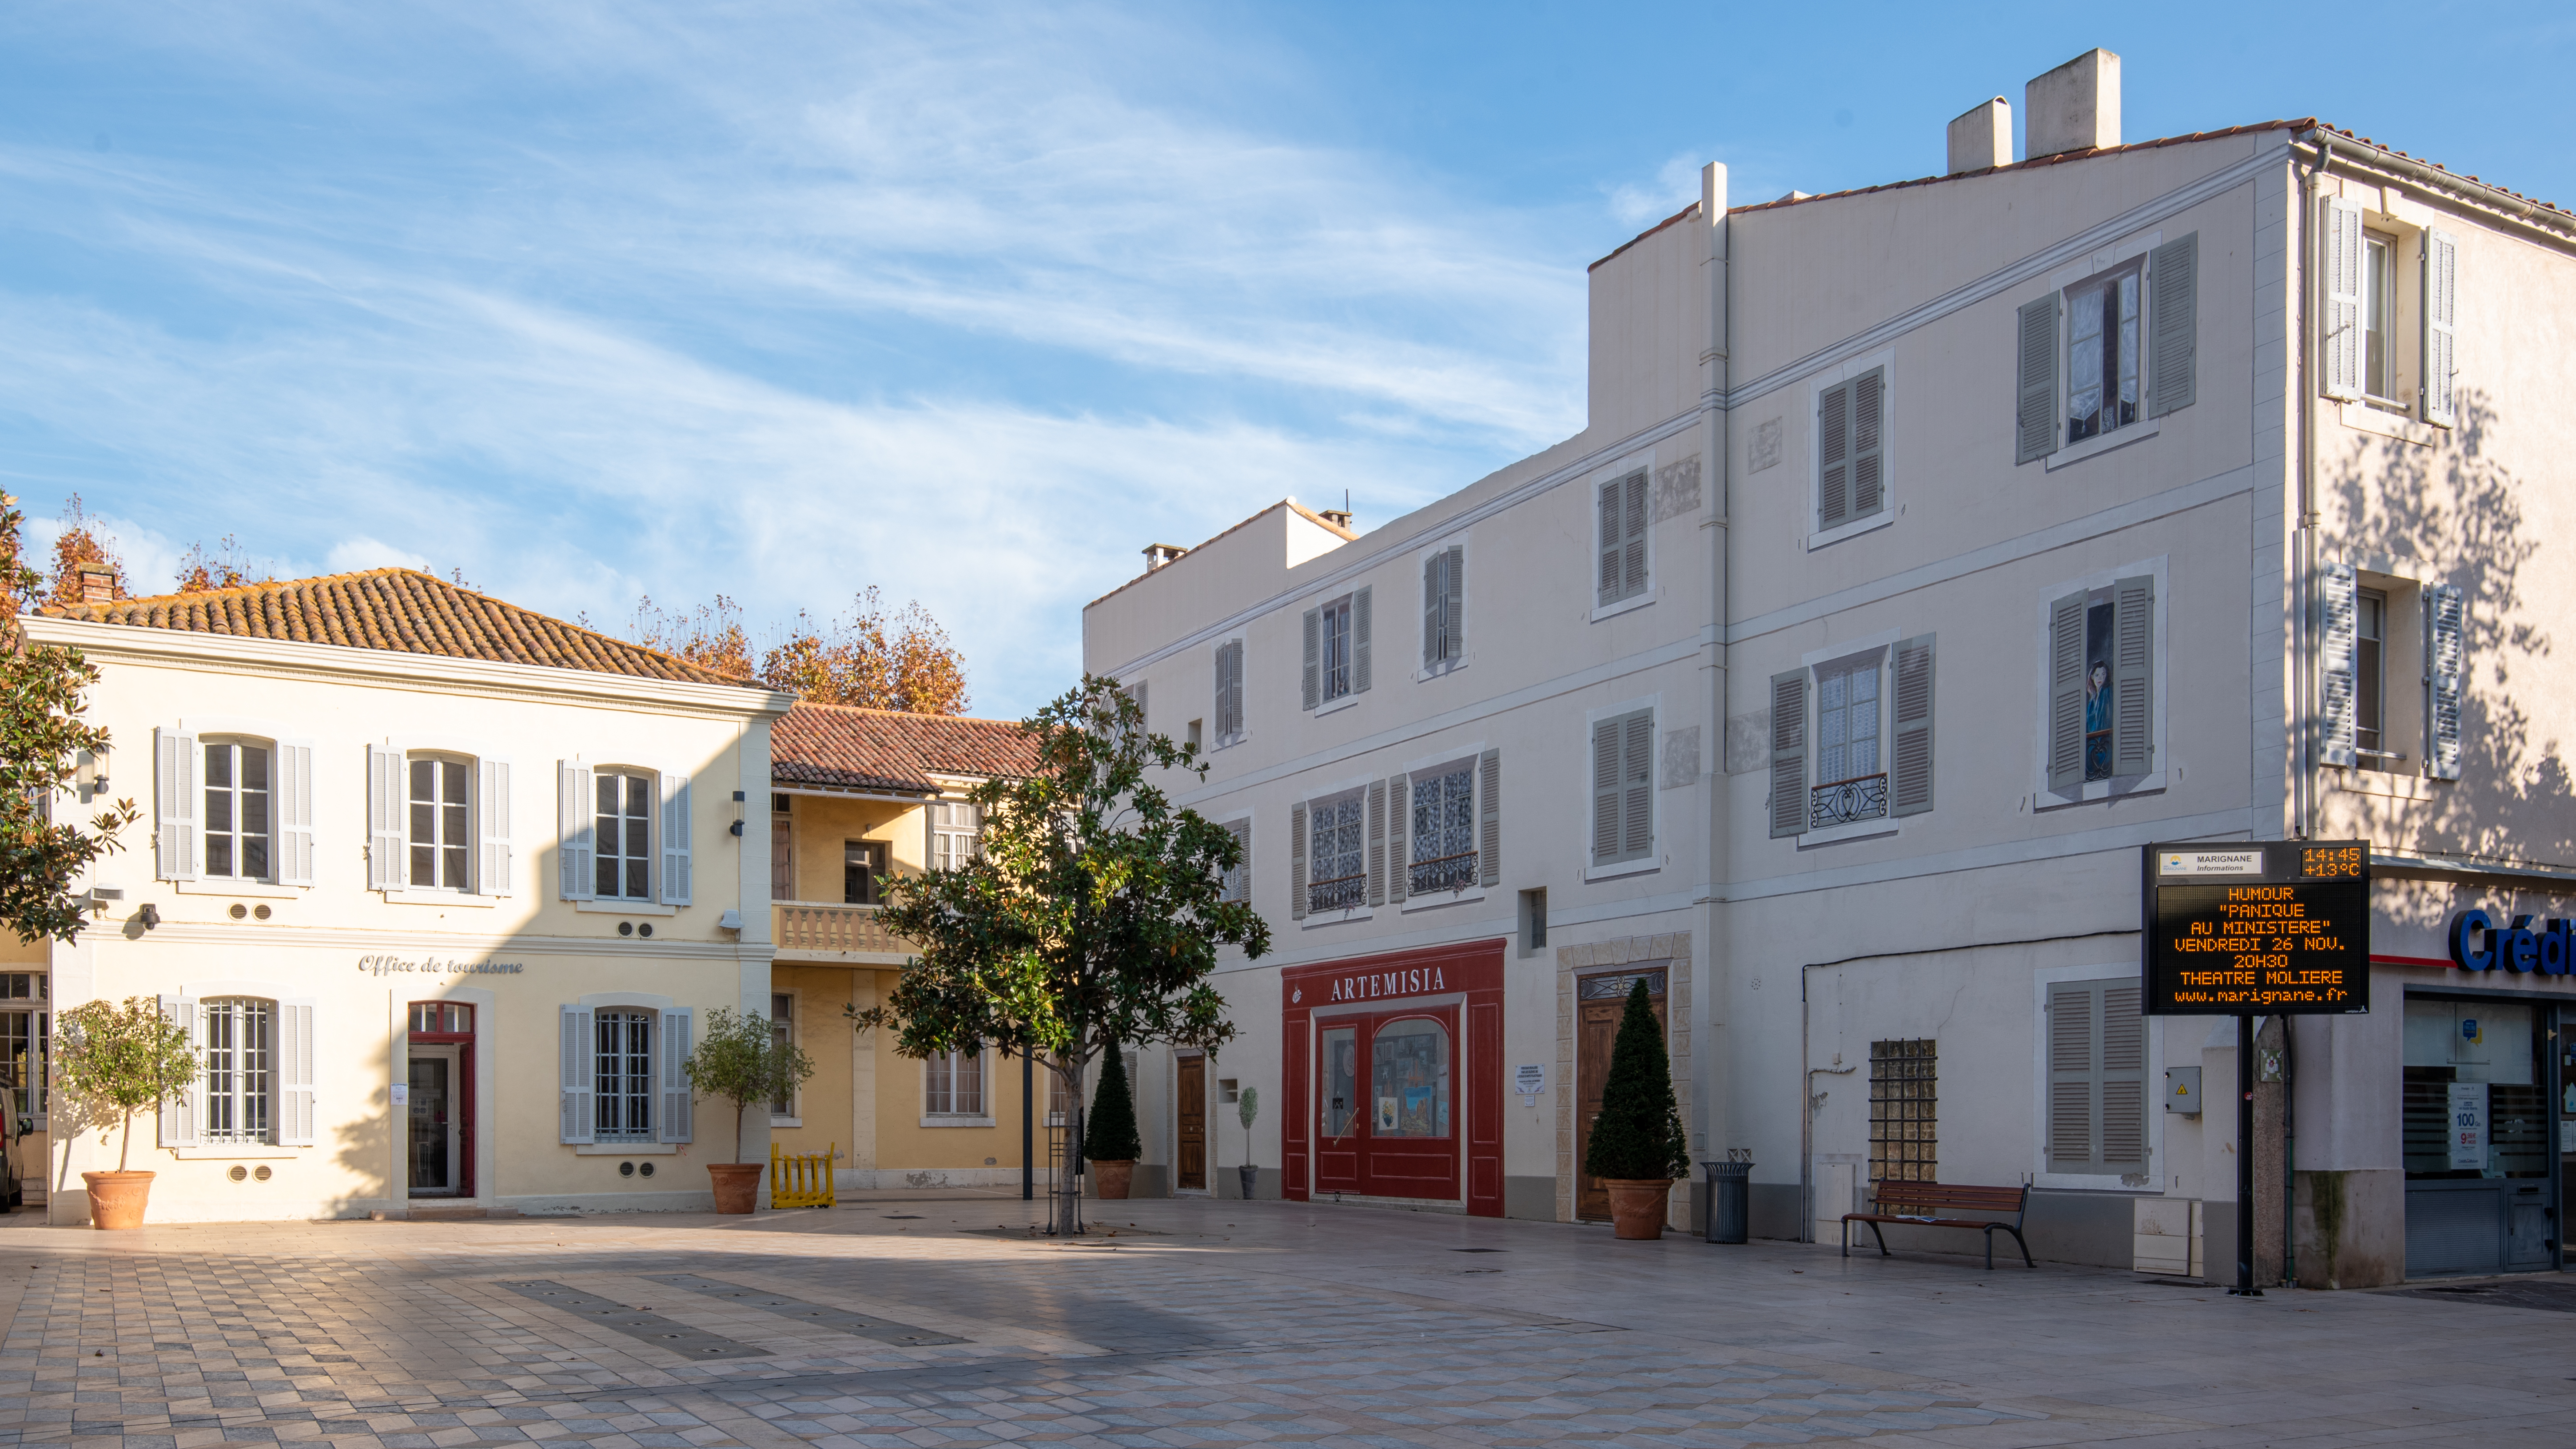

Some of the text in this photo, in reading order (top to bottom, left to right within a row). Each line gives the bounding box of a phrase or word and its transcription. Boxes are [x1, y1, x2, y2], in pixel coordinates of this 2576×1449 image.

[2305, 848, 2359, 861] 14:45
[2229, 888, 2293, 900] HUMOUR
[2220, 904, 2305, 918] "PANIQUE
[2191, 920, 2330, 935] AU MINISTERE"
[2175, 937, 2345, 952] VENDREDI 26 NOV.
[358, 955, 524, 976] Office de tourisme
[2234, 954, 2288, 968] 20H30
[1331, 967, 1445, 1000] ARTEMISIA
[2180, 971, 2342, 985] THEATRE MOLIERE
[2175, 987, 2347, 1004] www.marignane.fr
[2457, 1113, 2474, 1127] 100
